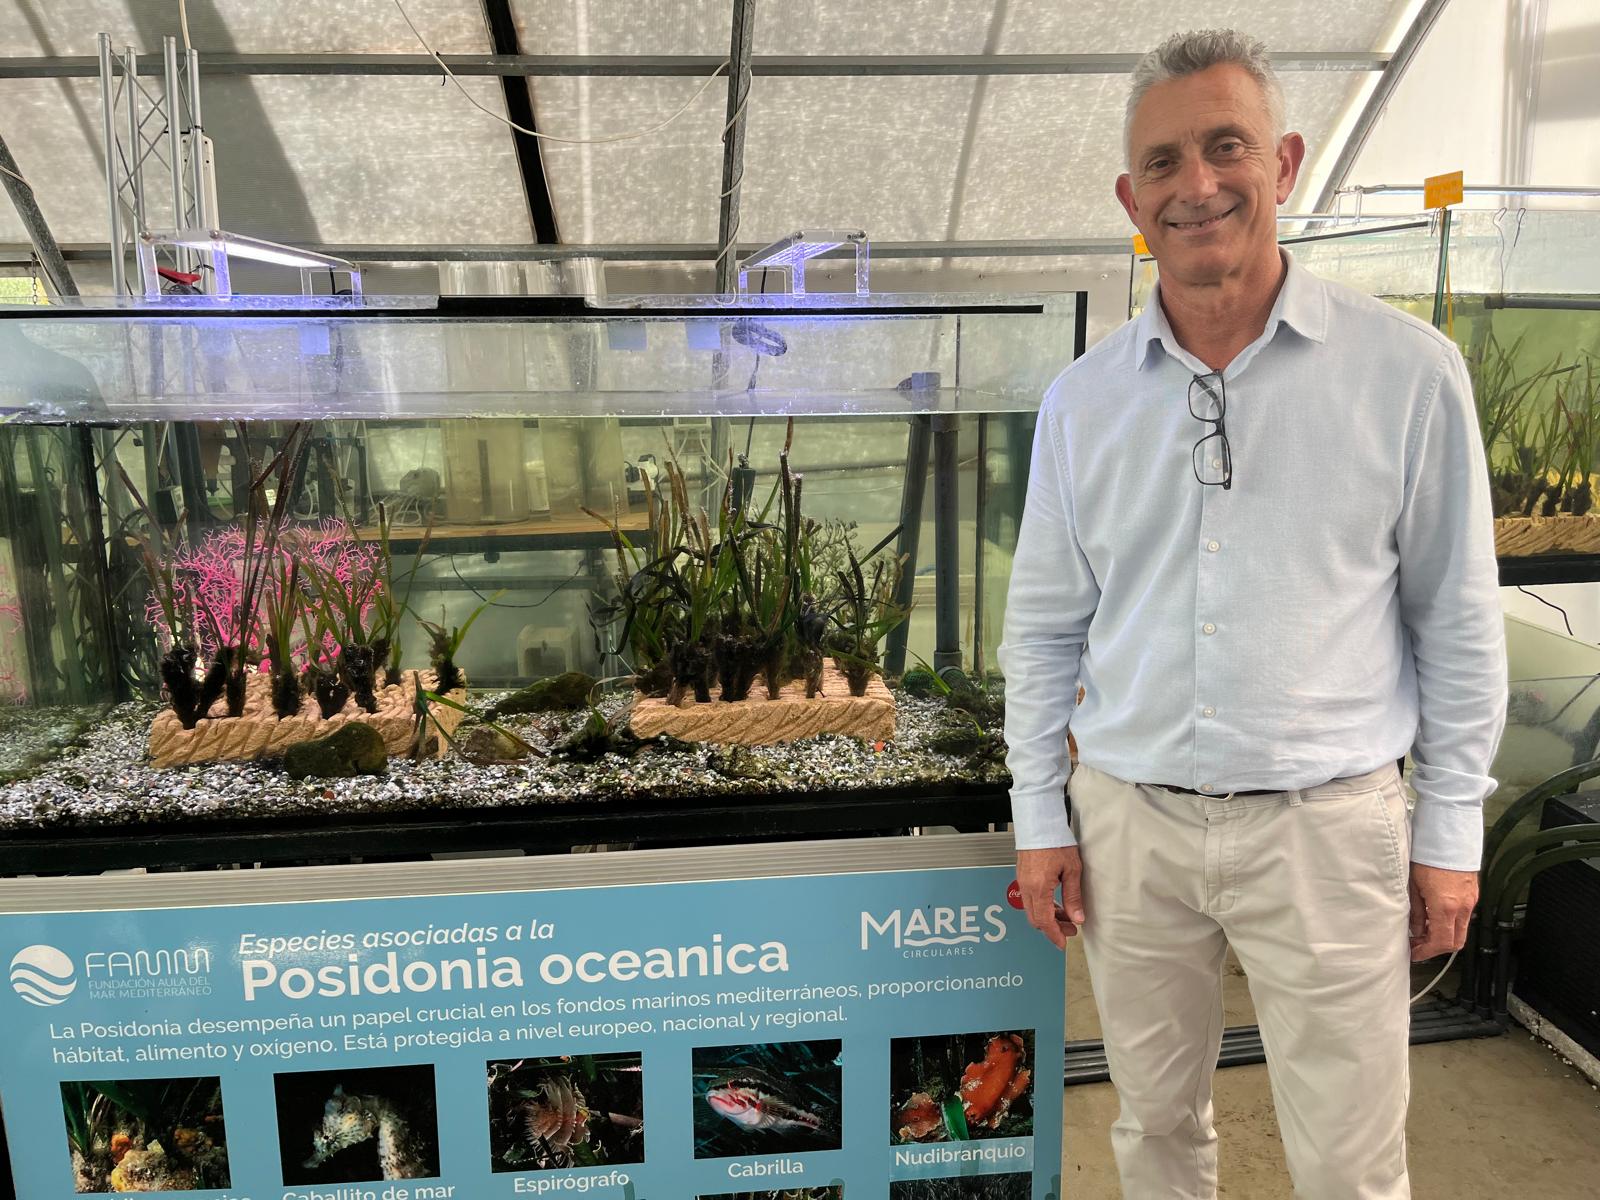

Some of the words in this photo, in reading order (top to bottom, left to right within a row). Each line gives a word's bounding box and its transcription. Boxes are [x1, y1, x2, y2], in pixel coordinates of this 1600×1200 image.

[238, 929, 354, 958] Especies
[362, 922, 498, 948] asociadas
[505, 924, 522, 941] a
[529, 919, 555, 940] la
[861, 904, 1007, 950] MARES
[85, 948, 210, 977] FAMM
[903, 947, 975, 959] CIRCULARES
[242, 947, 523, 1001] Posidonia
[539, 934, 789, 985] oceanica
[88, 976, 155, 990] FUNDACIÓN
[158, 977, 188, 988] AULA
[189, 976, 209, 986] DEL
[90, 990, 116, 1000] MAR
[119, 986, 212, 998] MEDITERRÁNEO
[50, 1024, 75, 1039] La
[81, 1019, 182, 1039] Posidonia
[188, 1013, 313, 1036] desempeña
[320, 1014, 346, 1028] un
[353, 1007, 412, 1030] papel
[416, 1003, 486, 1022] crucial
[490, 1005, 516, 1018] en
[522, 1000, 552, 1016] los
[557, 996, 626, 1014] fondos
[632, 992, 711, 1010] marinos
[716, 984, 862, 1006] mediterráneos,
[868, 972, 1024, 1000] proporcionando
[52, 1046, 130, 1064] hábitat,
[135, 1042, 227, 1062] alimento
[232, 1045, 244, 1062] y
[249, 1039, 337, 1059] oxígeno.
[344, 1032, 387, 1051] Está
[394, 1027, 493, 1052] protegida
[499, 1028, 511, 1041] a
[516, 1022, 564, 1040] nivel
[569, 1020, 657, 1038] europeo,
[663, 1012, 745, 1032] nacional
[749, 1014, 761, 1031] y
[765, 1006, 848, 1029] regional.
[895, 1144, 1026, 1167] Nudibranquio
[728, 1159, 804, 1178] Cabrilla
[382, 1186, 409, 1200] de
[415, 1185, 456, 1200] mar
[514, 1170, 630, 1195] Espirógrafo
